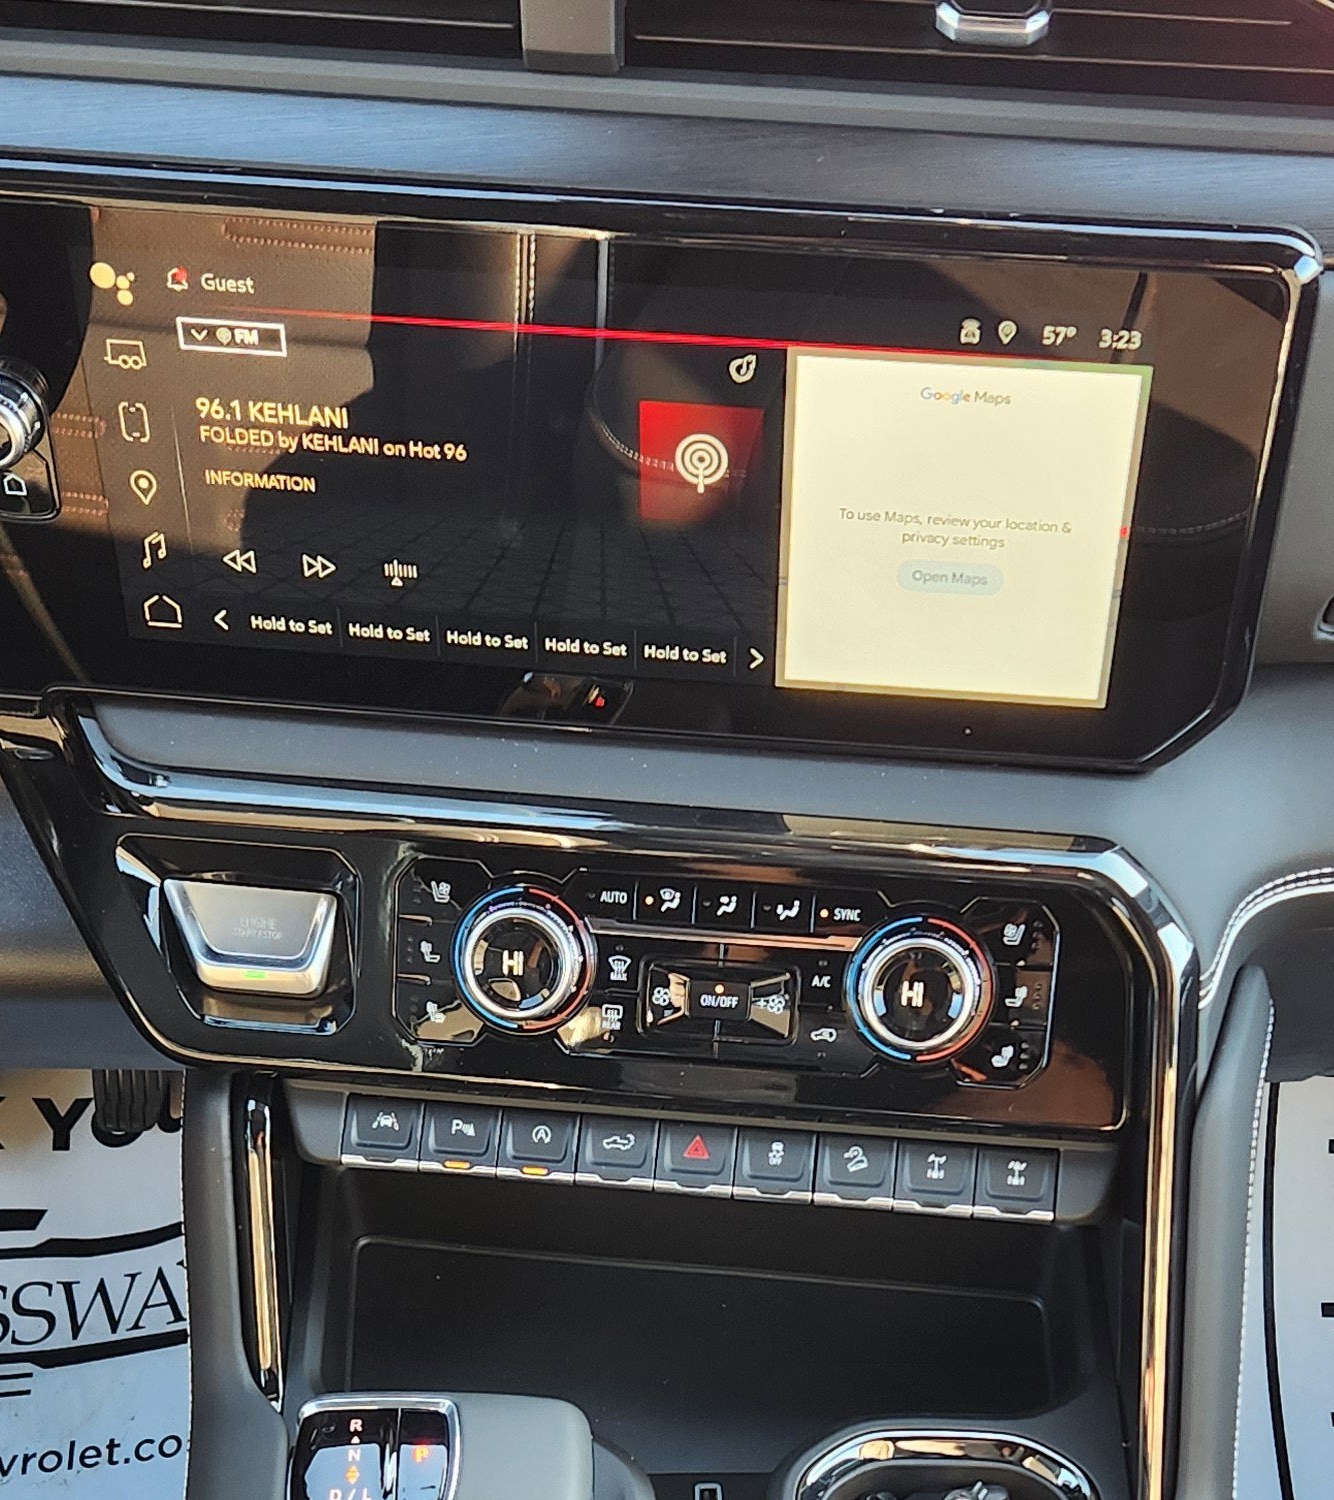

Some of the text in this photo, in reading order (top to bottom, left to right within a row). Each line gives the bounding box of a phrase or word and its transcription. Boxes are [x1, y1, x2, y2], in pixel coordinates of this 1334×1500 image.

[201, 273, 255, 294] Guest
[234, 328, 259, 345] FM
[1099, 329, 1142, 350] 3:23
[920, 387, 1012, 406] Google Maps
[195, 397, 349, 429] 96.1 KEHLANI
[199, 425, 467, 462] FOLDED by KEHLANI on Hot 96
[205, 469, 316, 493] INFORMATION
[839, 507, 1072, 534] To use Maps, review your location &
[901, 532, 1005, 550] privacy settings
[912, 569, 988, 586] Open Maps
[250, 615, 333, 635] Hold to Set
[348, 623, 431, 643] Hold to Set
[446, 630, 529, 650] Hold to Set
[544, 637, 628, 657] Hold to Set
[644, 645, 727, 664] Hold to Set
[599, 891, 628, 904] AUTO
[833, 908, 862, 922] SYNC
[502, 950, 524, 976] HI
[811, 975, 832, 988] A/C
[700, 996, 738, 1009] ON/OFF
[900, 981, 924, 1008] HI
[349, 1418, 363, 1432] R
[348, 1448, 361, 1462] N
[413, 1446, 429, 1463] P
